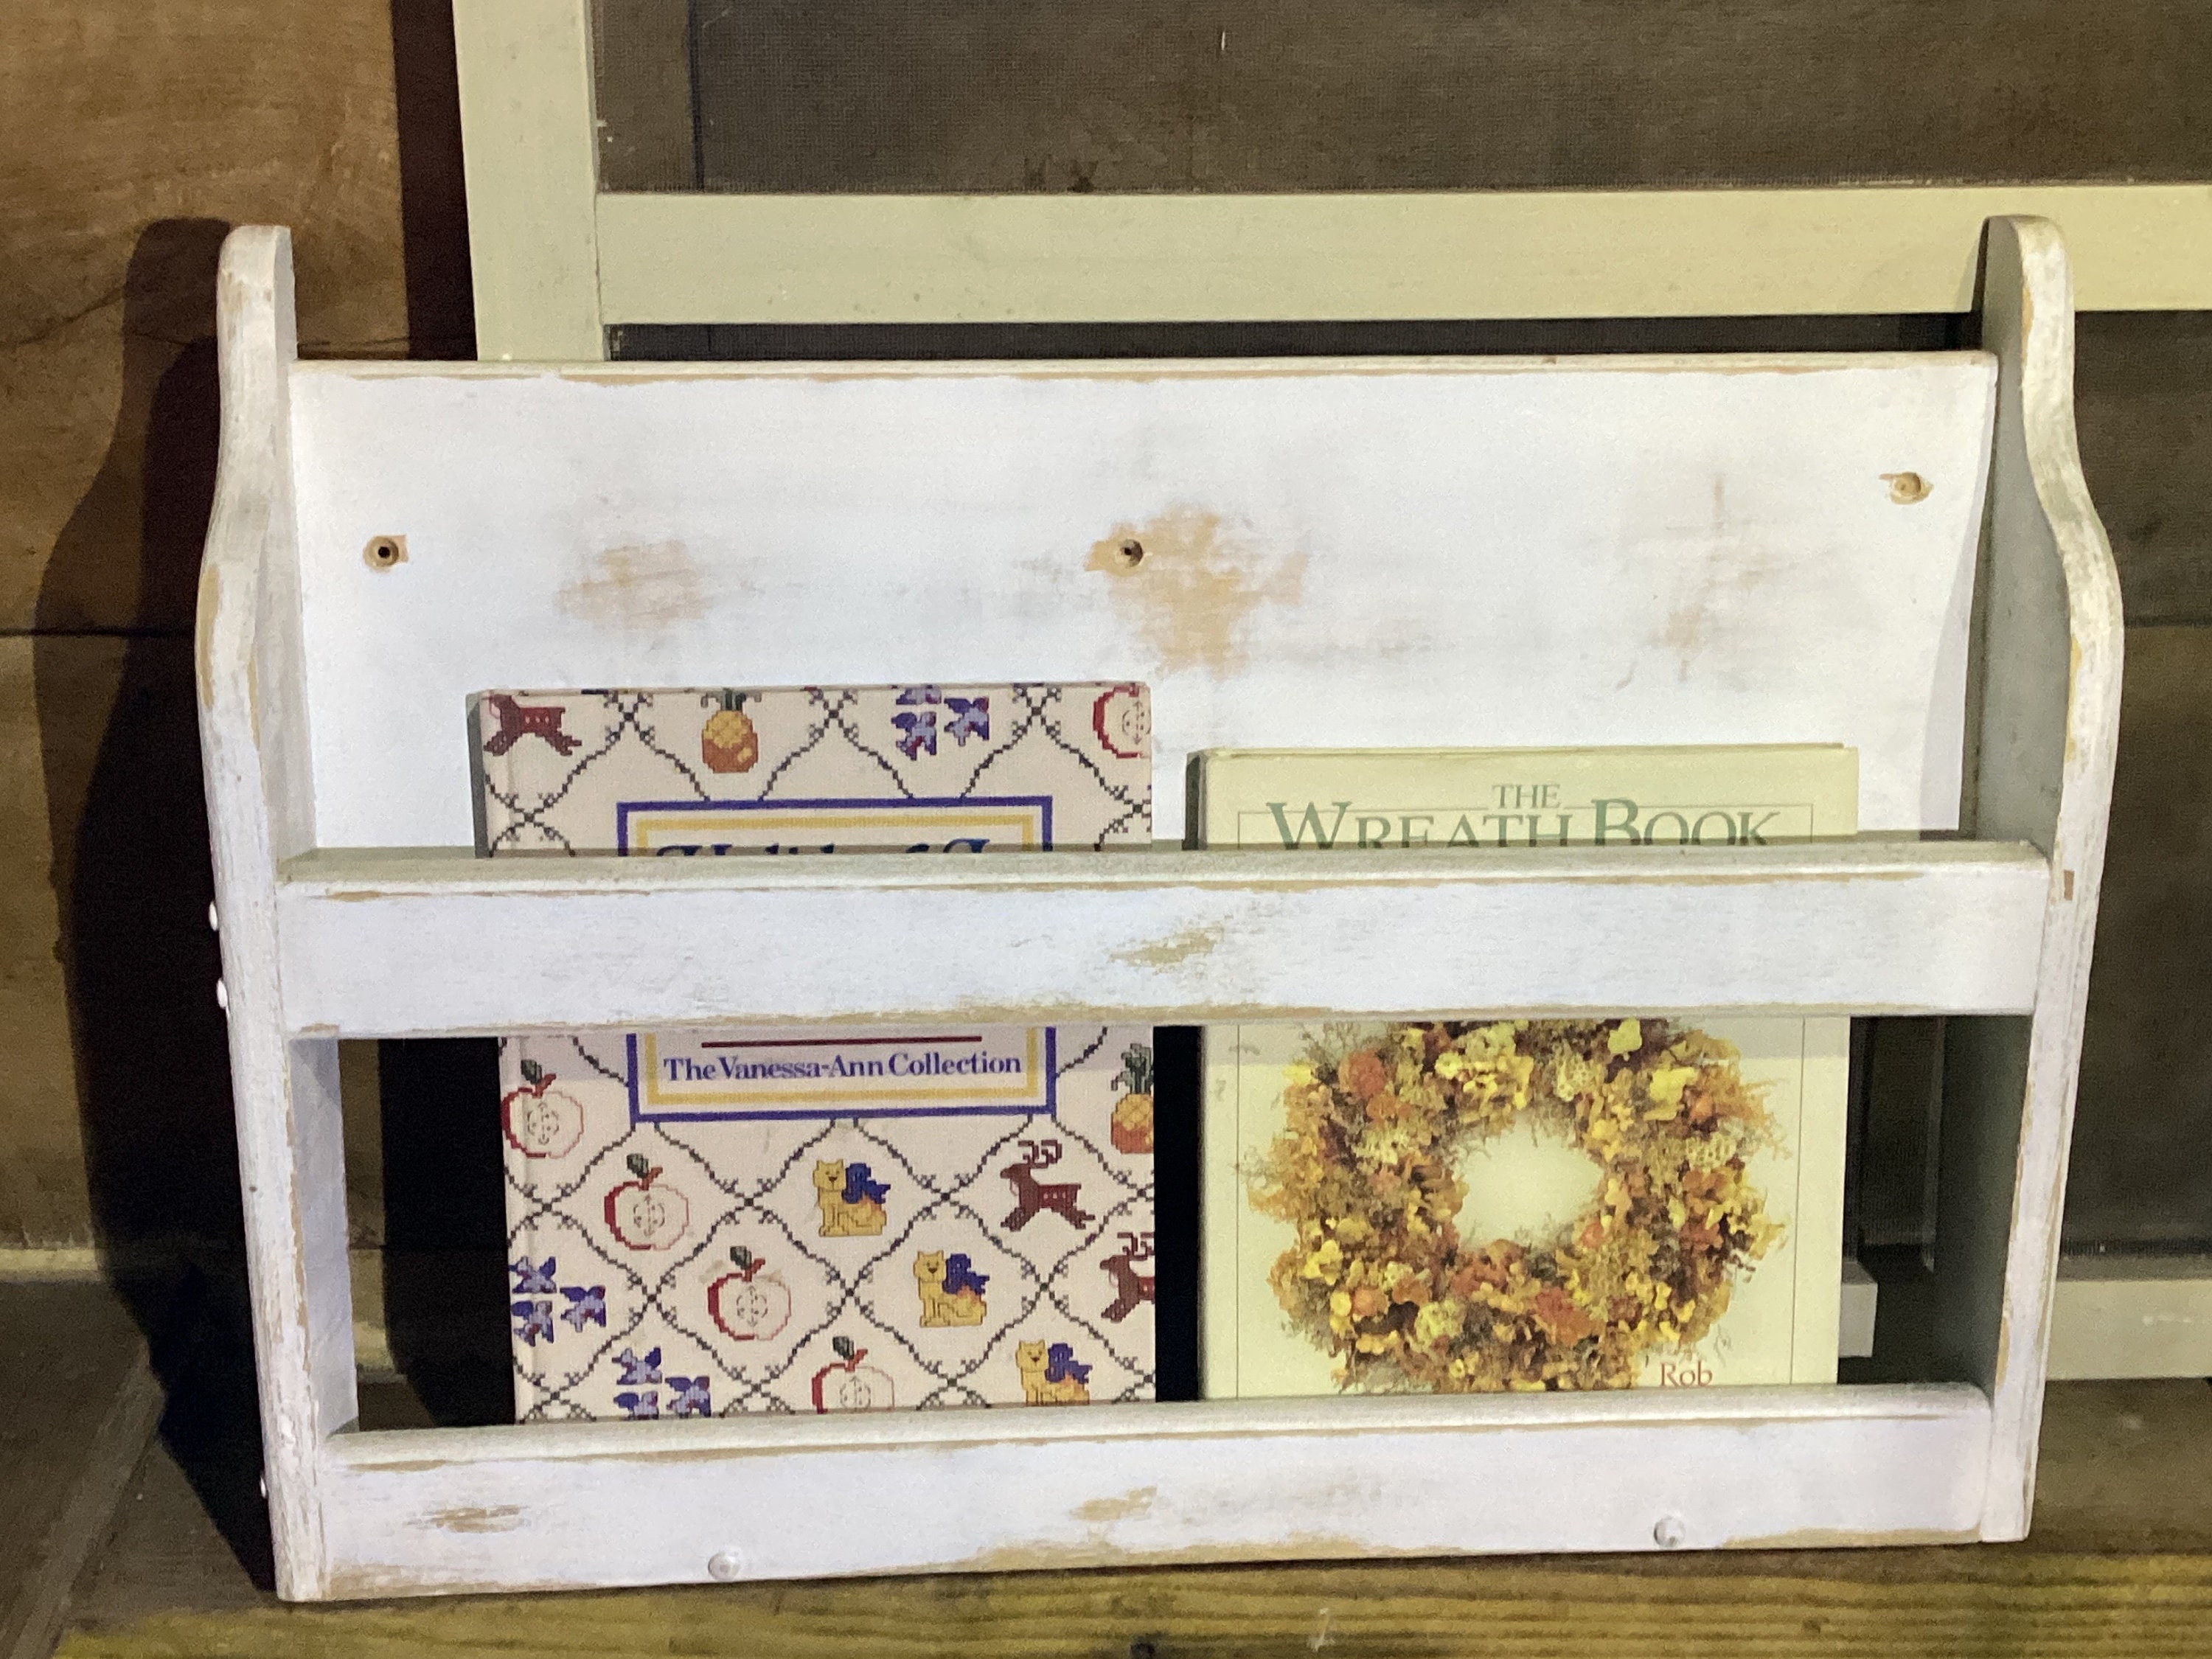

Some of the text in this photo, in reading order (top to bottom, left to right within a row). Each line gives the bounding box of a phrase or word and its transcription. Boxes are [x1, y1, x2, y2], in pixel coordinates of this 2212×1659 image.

[1492, 783, 1561, 810] THE
[1266, 798, 1781, 849] WREATH BOOK
[664, 1050, 1021, 1081] The Vanessa-Ann Collection
[1660, 1360, 1713, 1387] Rob
